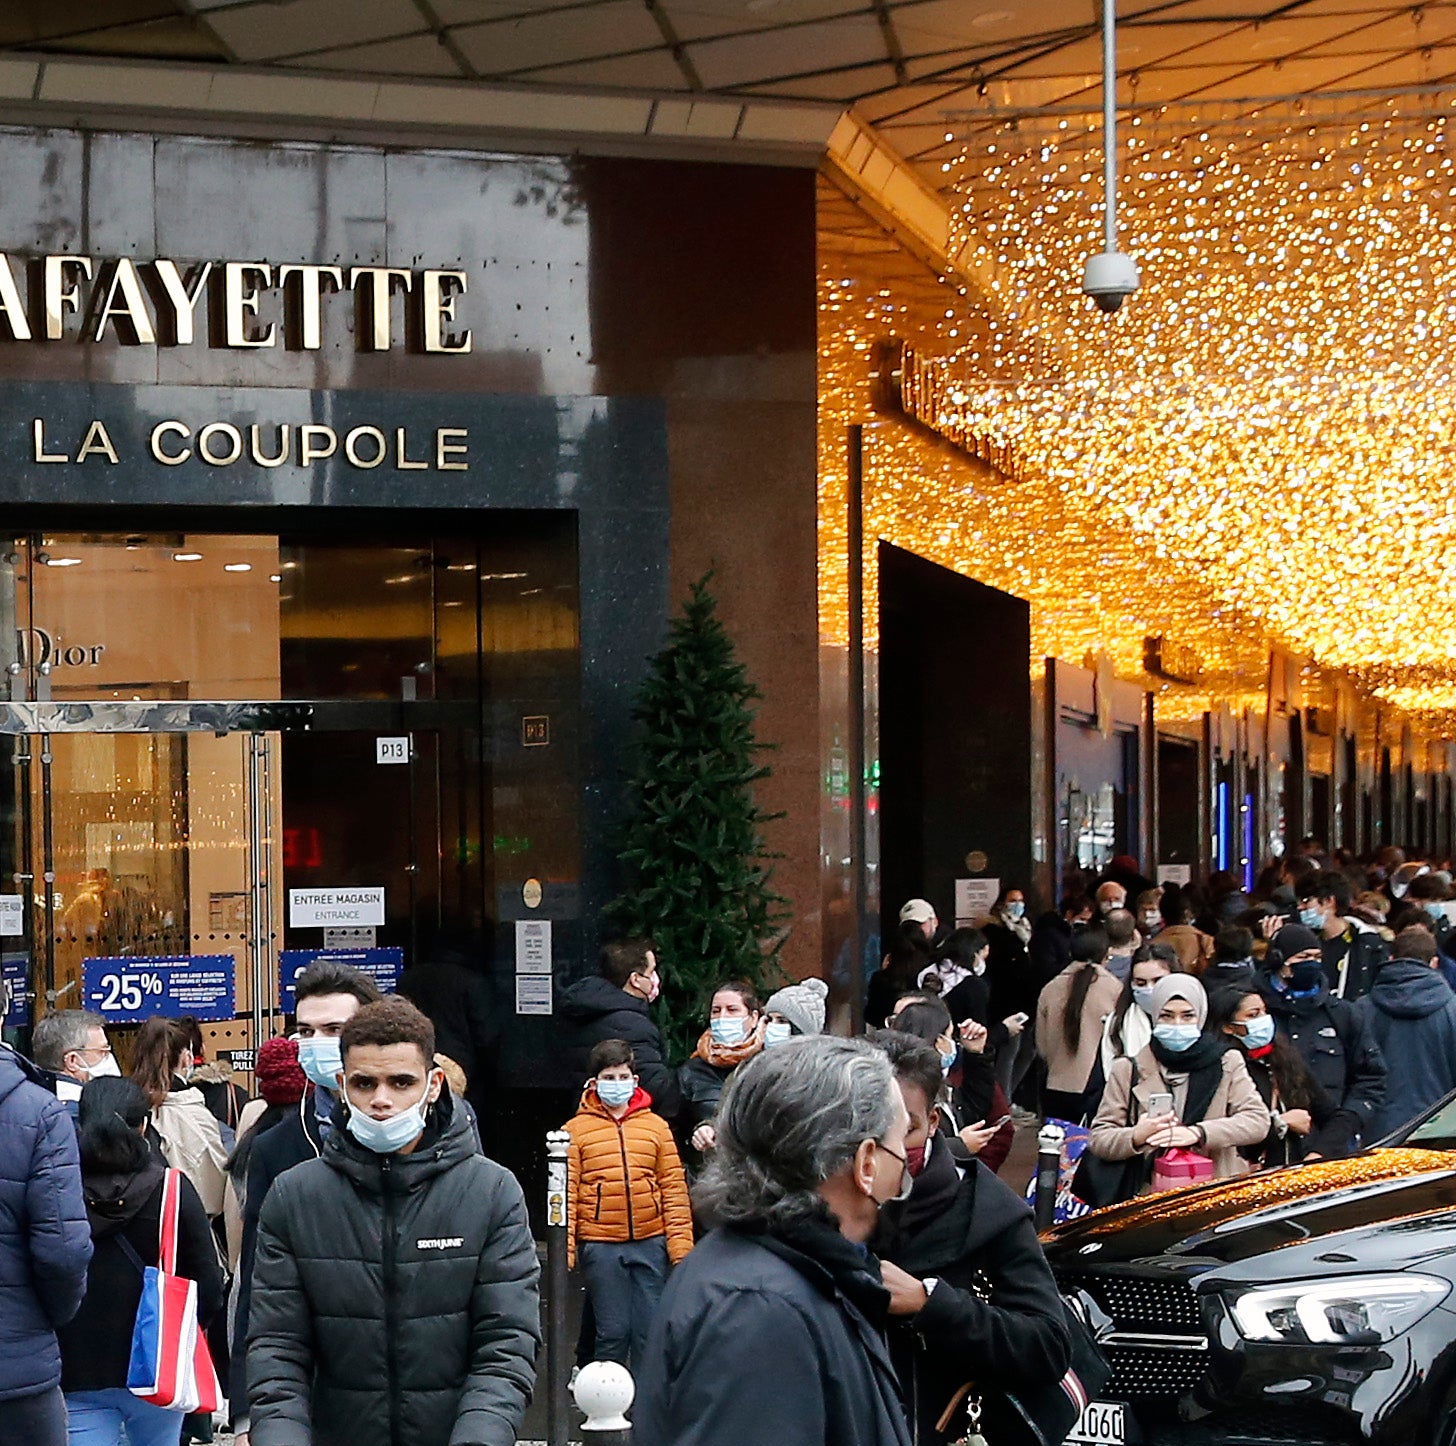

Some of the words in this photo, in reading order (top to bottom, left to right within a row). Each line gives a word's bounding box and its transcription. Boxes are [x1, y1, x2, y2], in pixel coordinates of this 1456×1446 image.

[33, 418, 119, 464] LA
[150, 420, 470, 472] COUPOLE
[17, 628, 105, 674] Dior
[381, 744, 403, 757] P13
[294, 893, 333, 905] ENTRÉE
[336, 893, 381, 904] MAGASIN
[314, 910, 360, 920] ENTRANCE
[91, 972, 163, 1011] -25%
[232, 1061, 255, 1071] PULL
